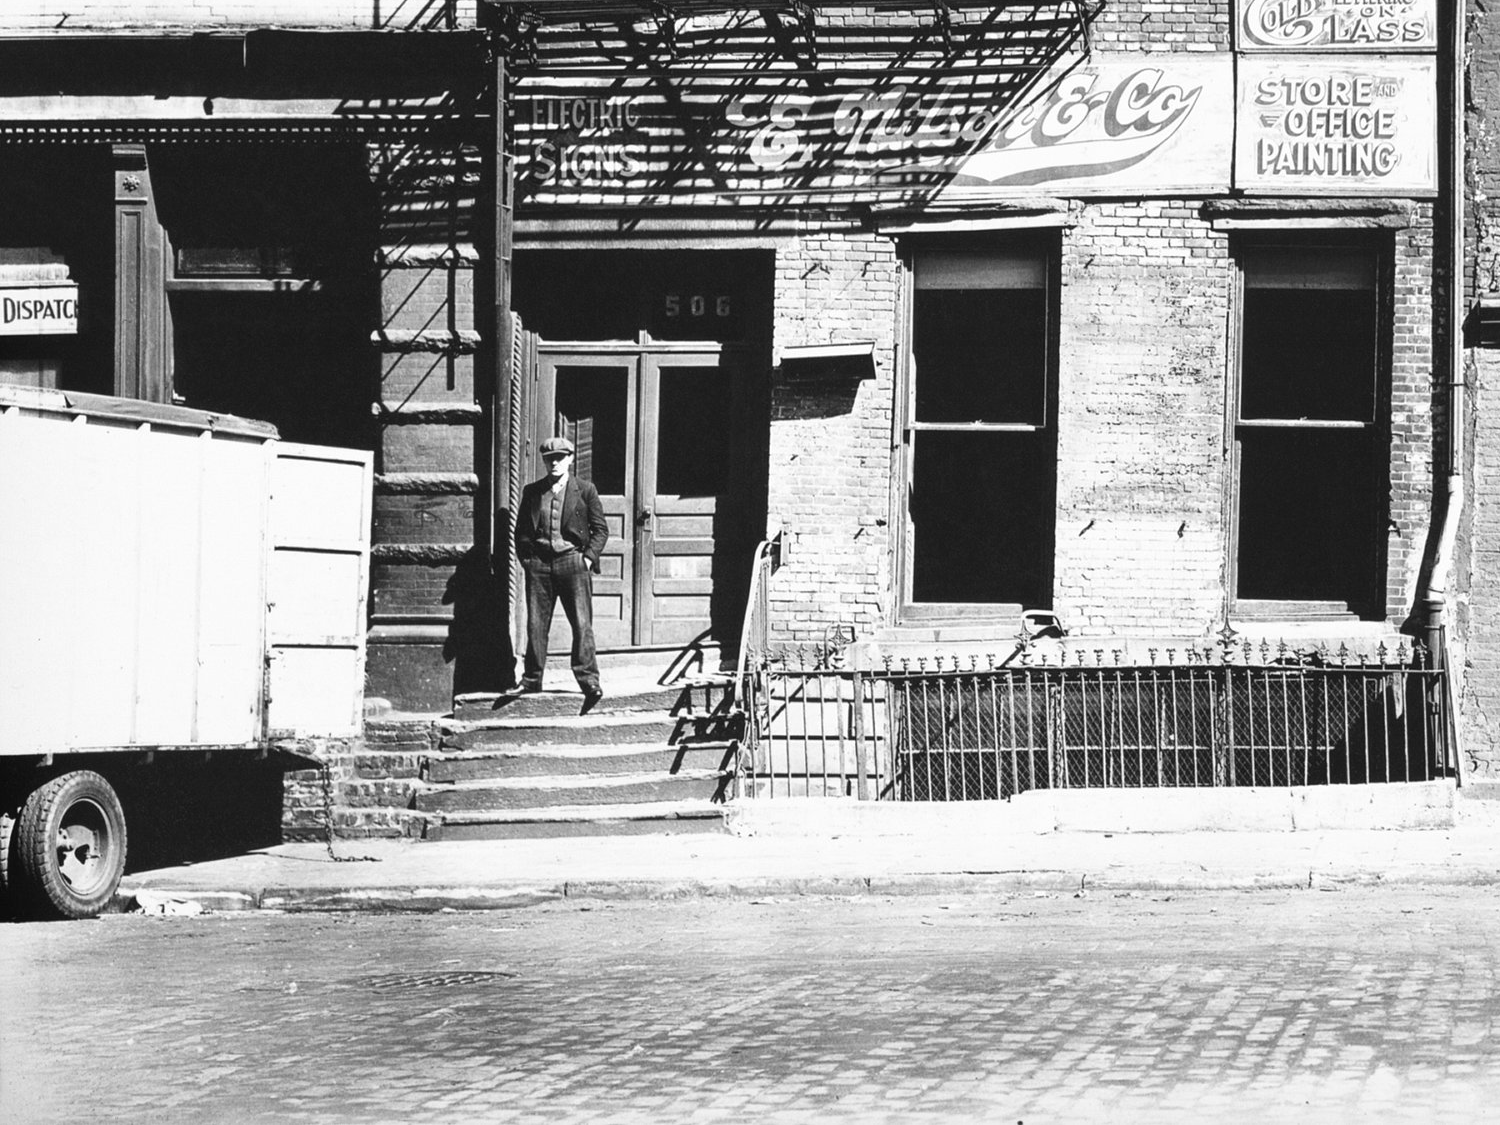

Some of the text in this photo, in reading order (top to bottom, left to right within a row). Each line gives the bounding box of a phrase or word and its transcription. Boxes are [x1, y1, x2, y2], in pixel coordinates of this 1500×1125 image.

[1359, 5, 1396, 18] ON
[1255, 77, 1398, 106] STORE AND
[532, 97, 639, 128] ELECTRIC
[1284, 108, 1397, 139] OFFICE
[533, 142, 639, 180] SIGNS
[1257, 138, 1400, 176] PAINTING
[665, 295, 731, 316] 506
